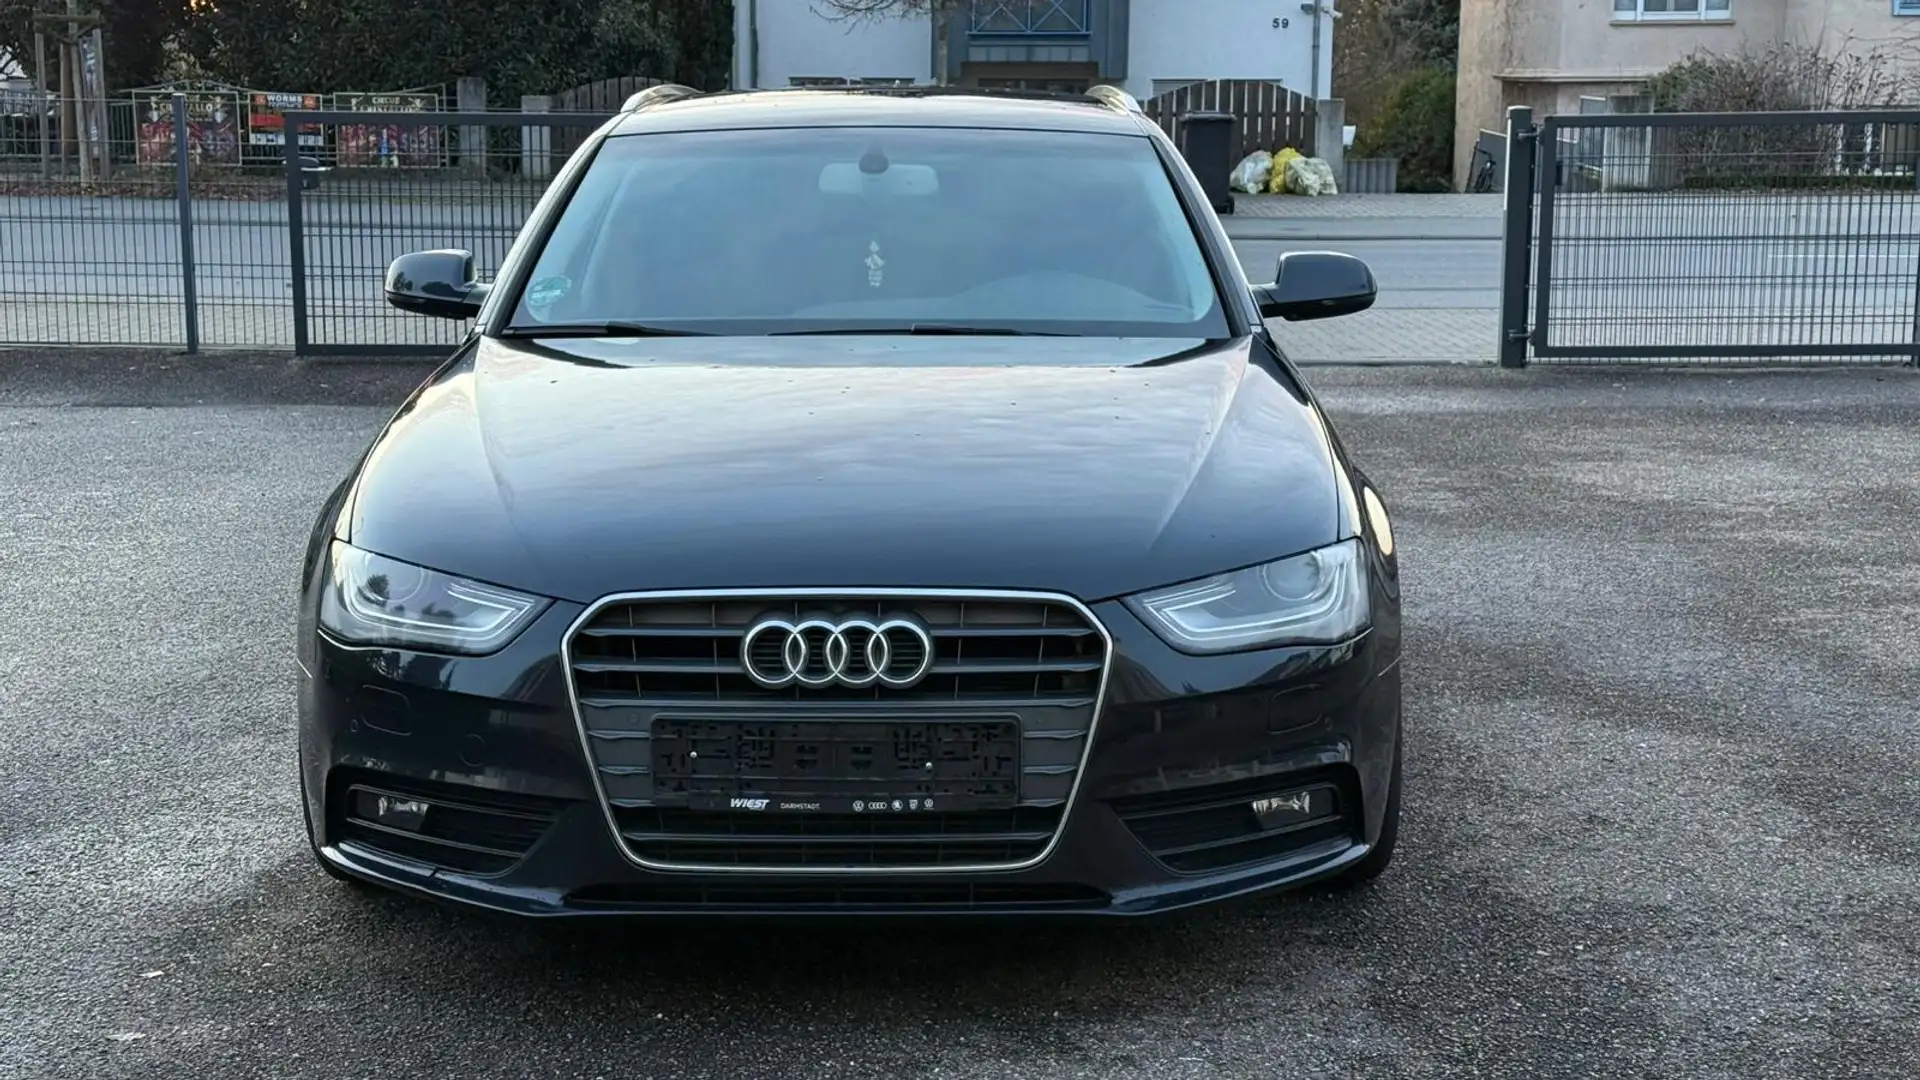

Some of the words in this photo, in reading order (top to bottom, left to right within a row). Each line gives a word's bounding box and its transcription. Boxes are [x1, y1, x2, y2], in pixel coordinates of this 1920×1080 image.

[1272, 17, 1289, 29] 59
[266, 94, 303, 103] WORMS
[730, 798, 770, 810] WIEST
[780, 802, 821, 810] DARMSTADT
